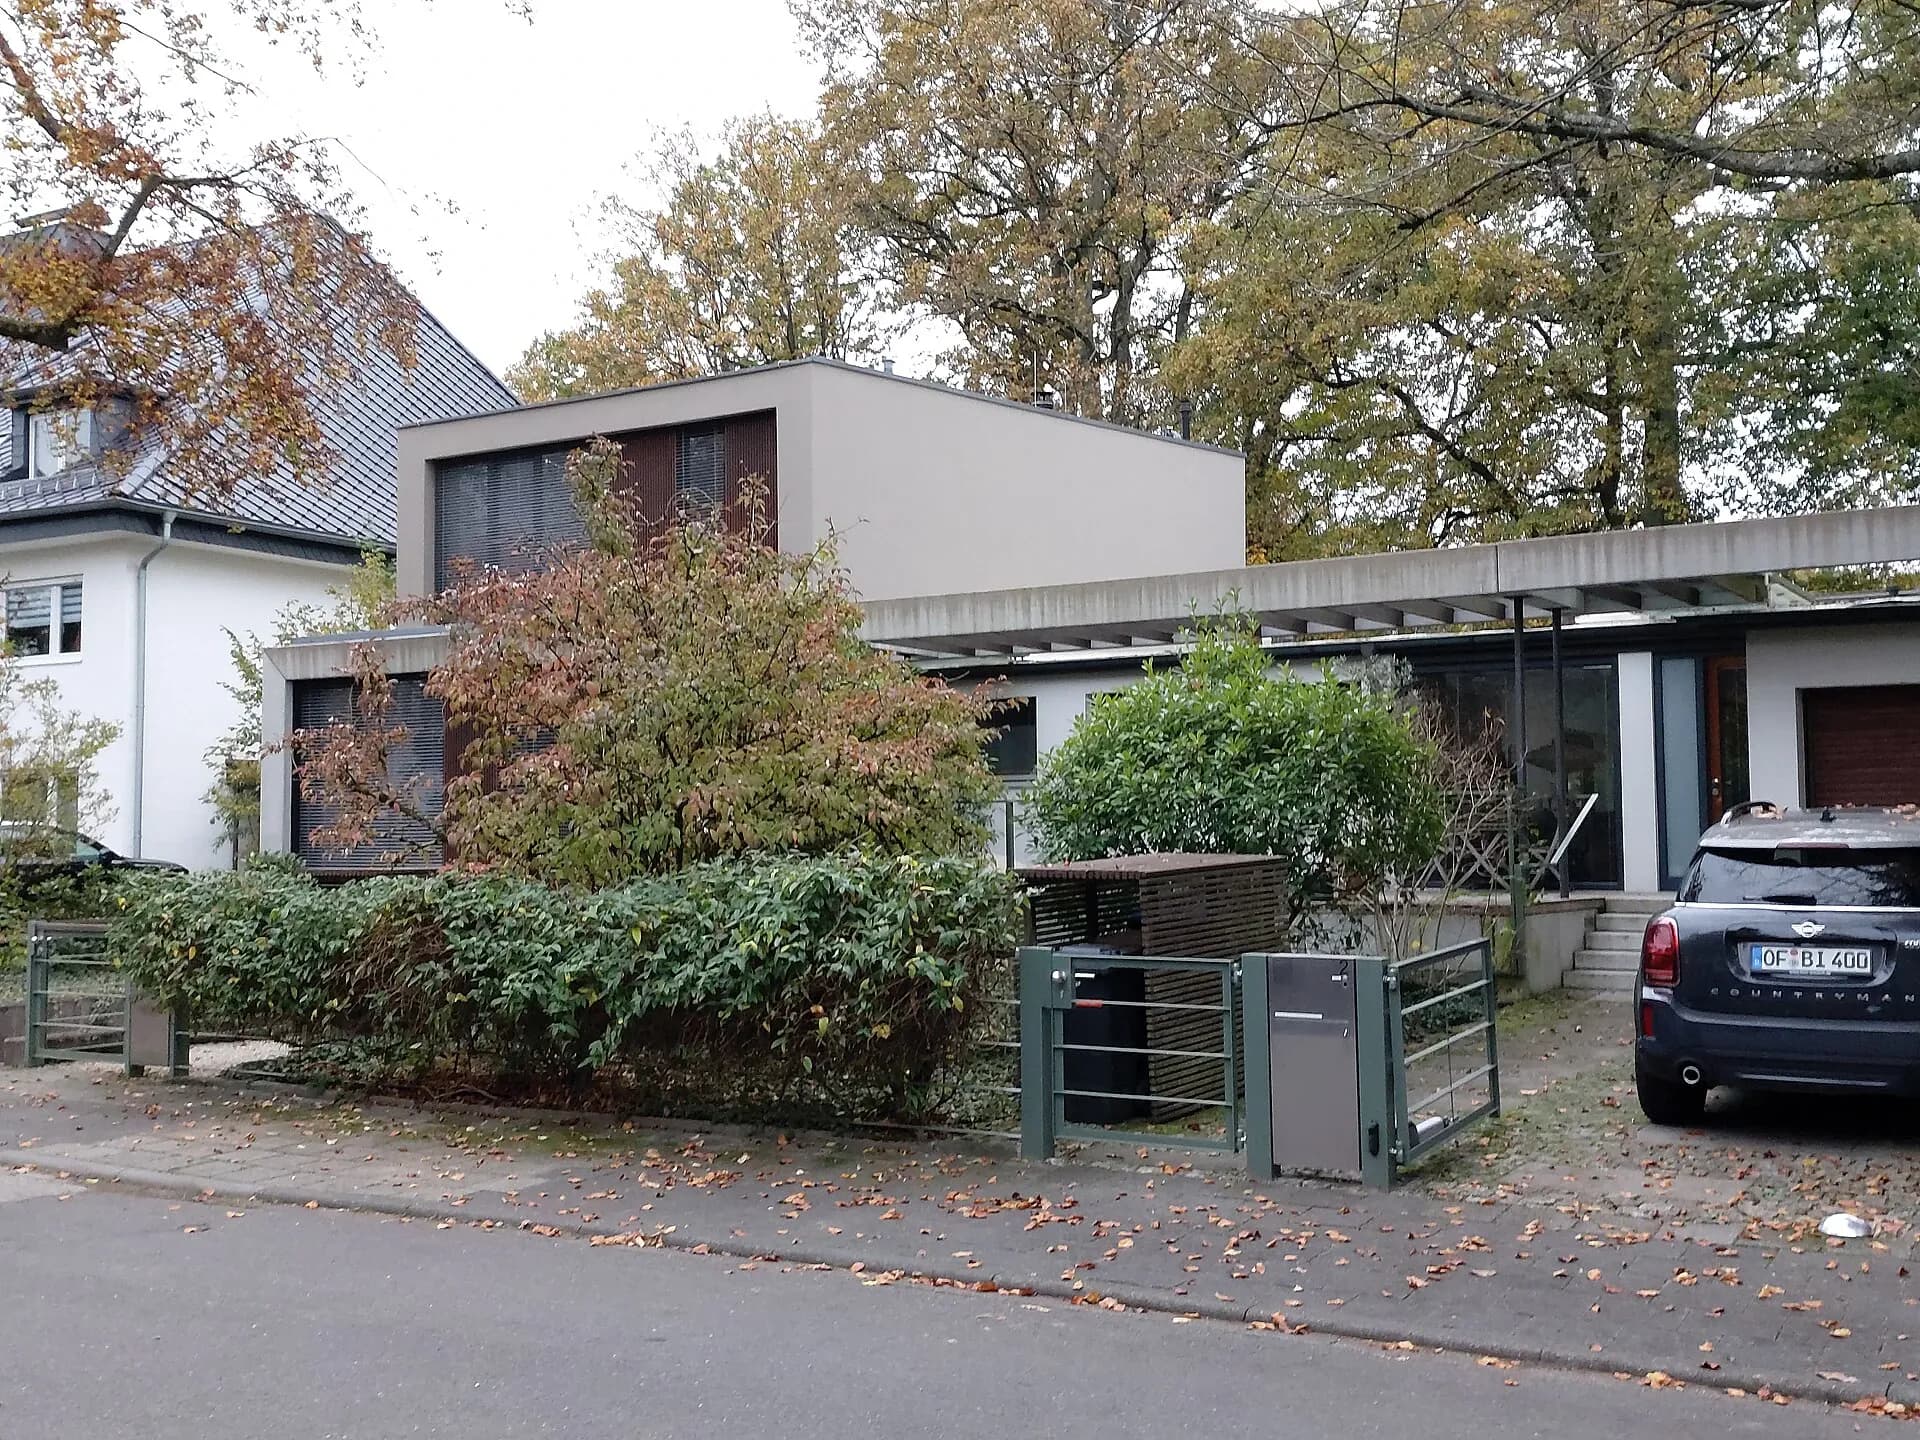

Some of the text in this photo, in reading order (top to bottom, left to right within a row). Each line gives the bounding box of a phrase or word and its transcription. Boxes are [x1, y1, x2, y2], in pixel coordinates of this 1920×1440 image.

[1764, 950, 1788, 966] OF
[1802, 951, 1825, 967] BI
[1832, 951, 1868, 968] 400
[1711, 987, 1915, 1002] COUNTRYMAN
